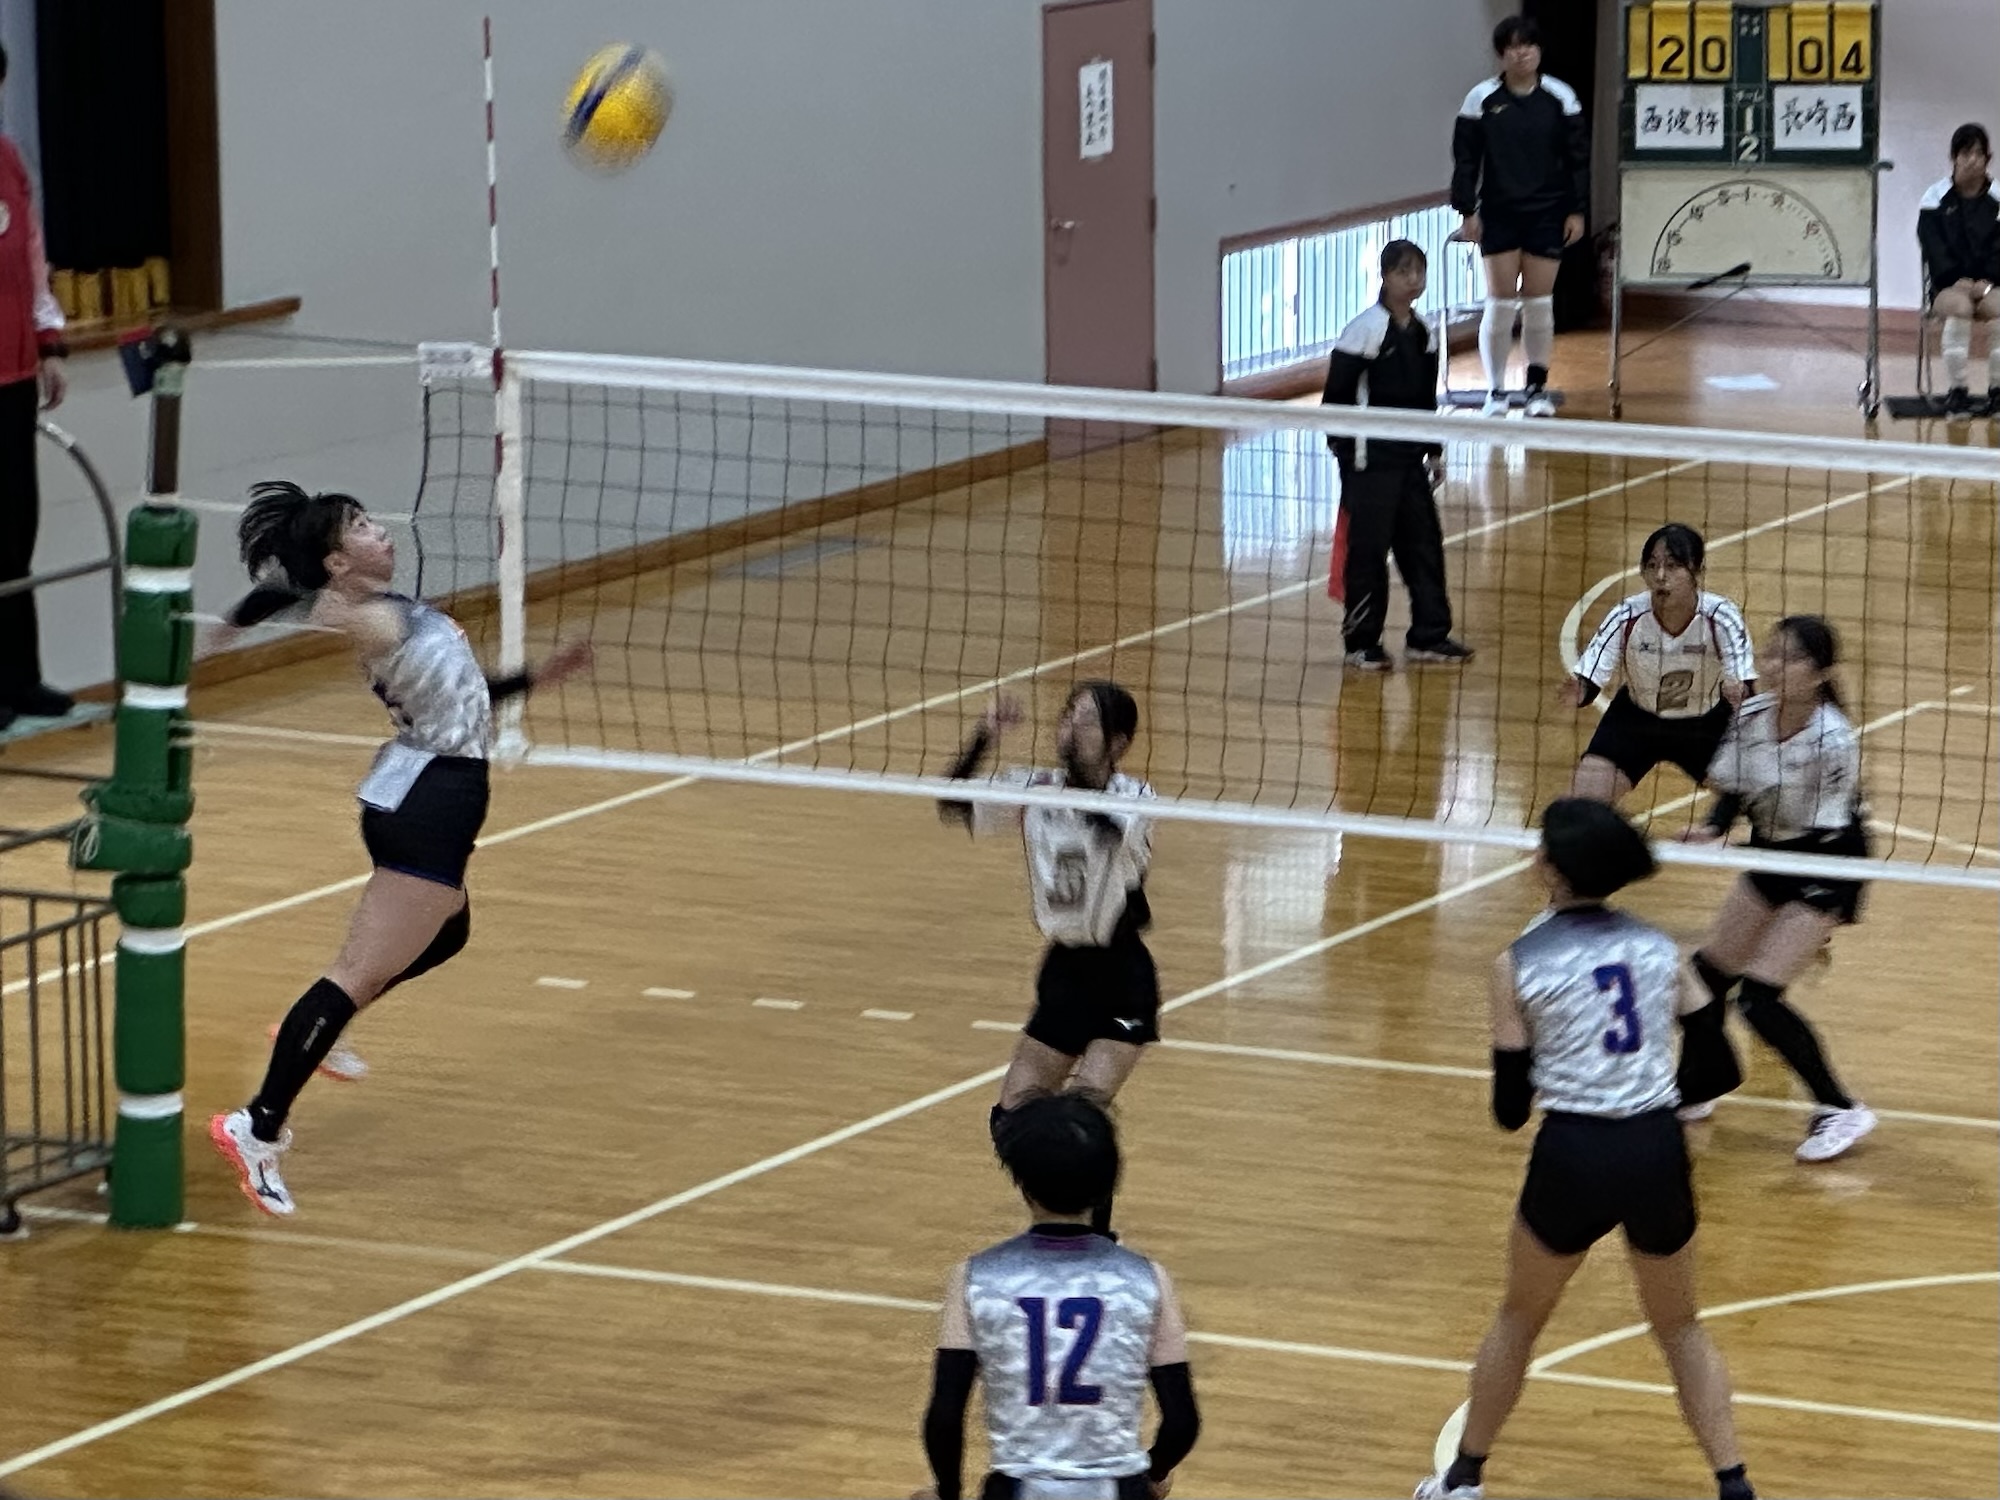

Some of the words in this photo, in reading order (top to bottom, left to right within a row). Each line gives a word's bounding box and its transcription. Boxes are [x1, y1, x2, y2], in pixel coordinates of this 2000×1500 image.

[1657, 34, 1727, 74] 20
[1798, 36, 1865, 75] 04
[1738, 134, 1760, 162] 2
[1656, 668, 1695, 712] 2
[1592, 962, 1643, 1055] 3
[1017, 1297, 1105, 1406] 12
